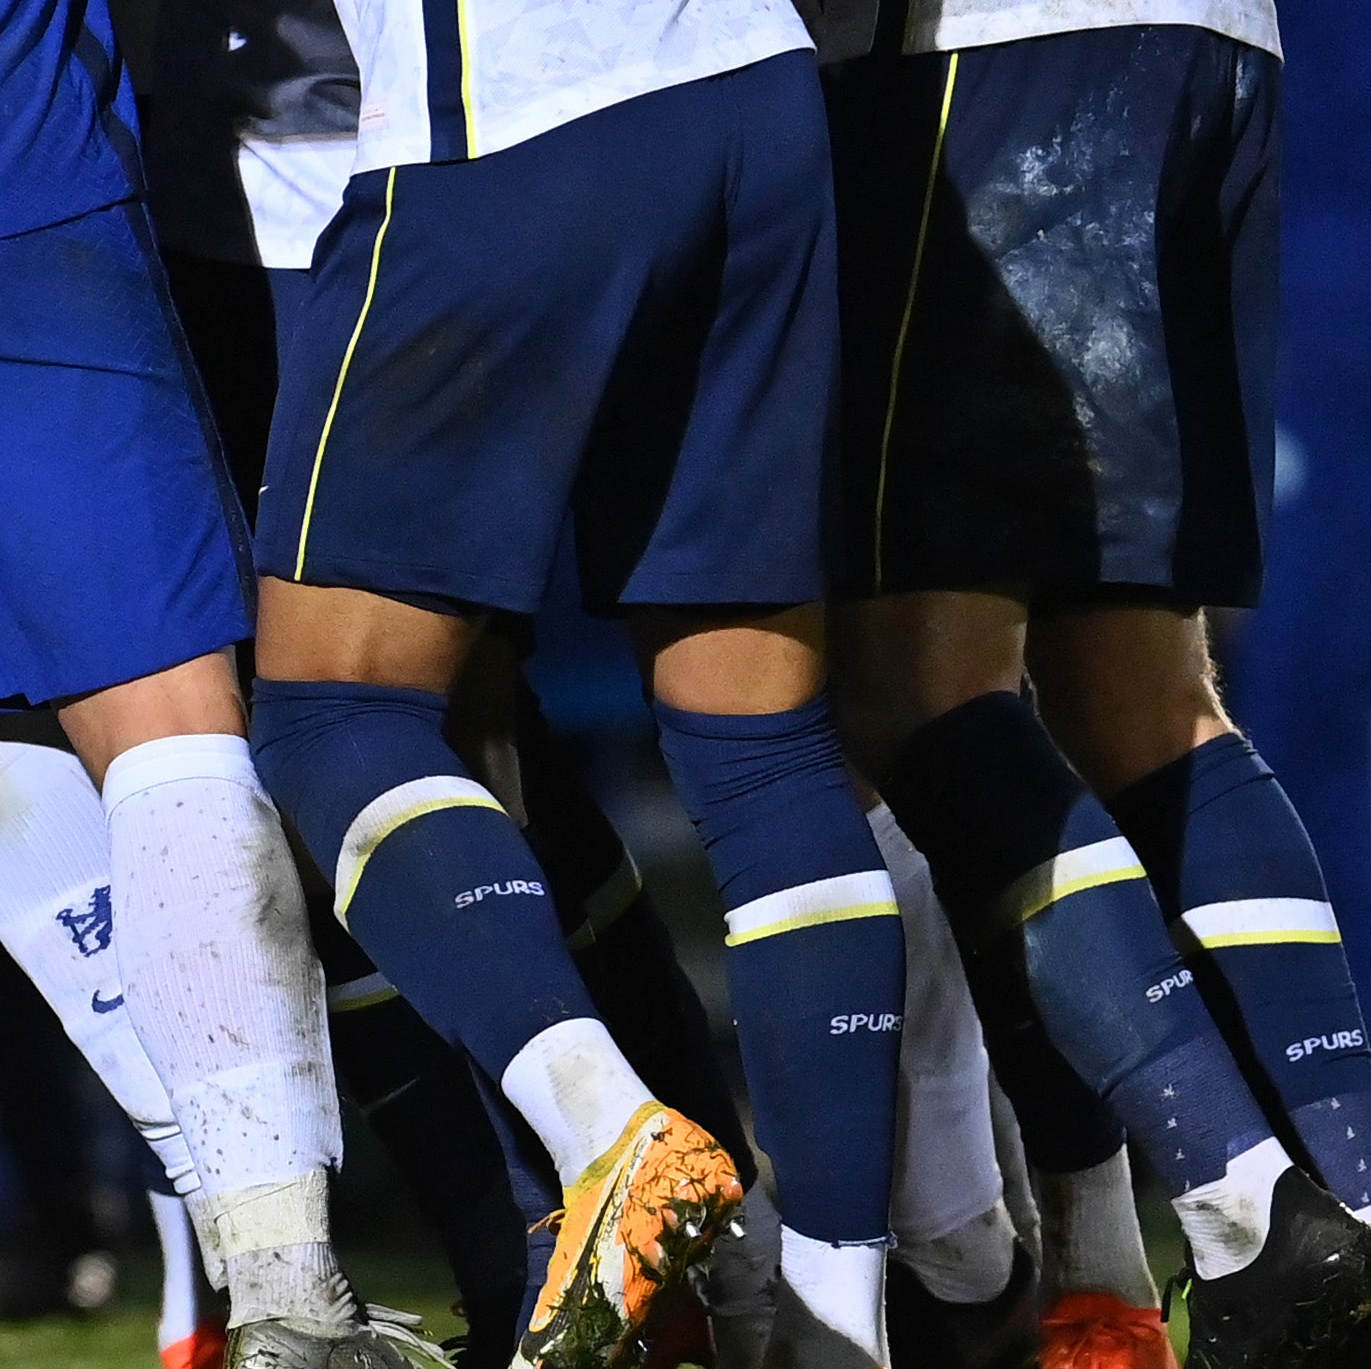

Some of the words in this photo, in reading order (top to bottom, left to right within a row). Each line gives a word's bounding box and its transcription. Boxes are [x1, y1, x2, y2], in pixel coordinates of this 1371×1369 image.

[454, 880, 545, 908] SPURS
[1145, 969, 1194, 1003] SPUR
[829, 1013, 903, 1035] SPURS
[1285, 1029, 1364, 1062] SPURS
